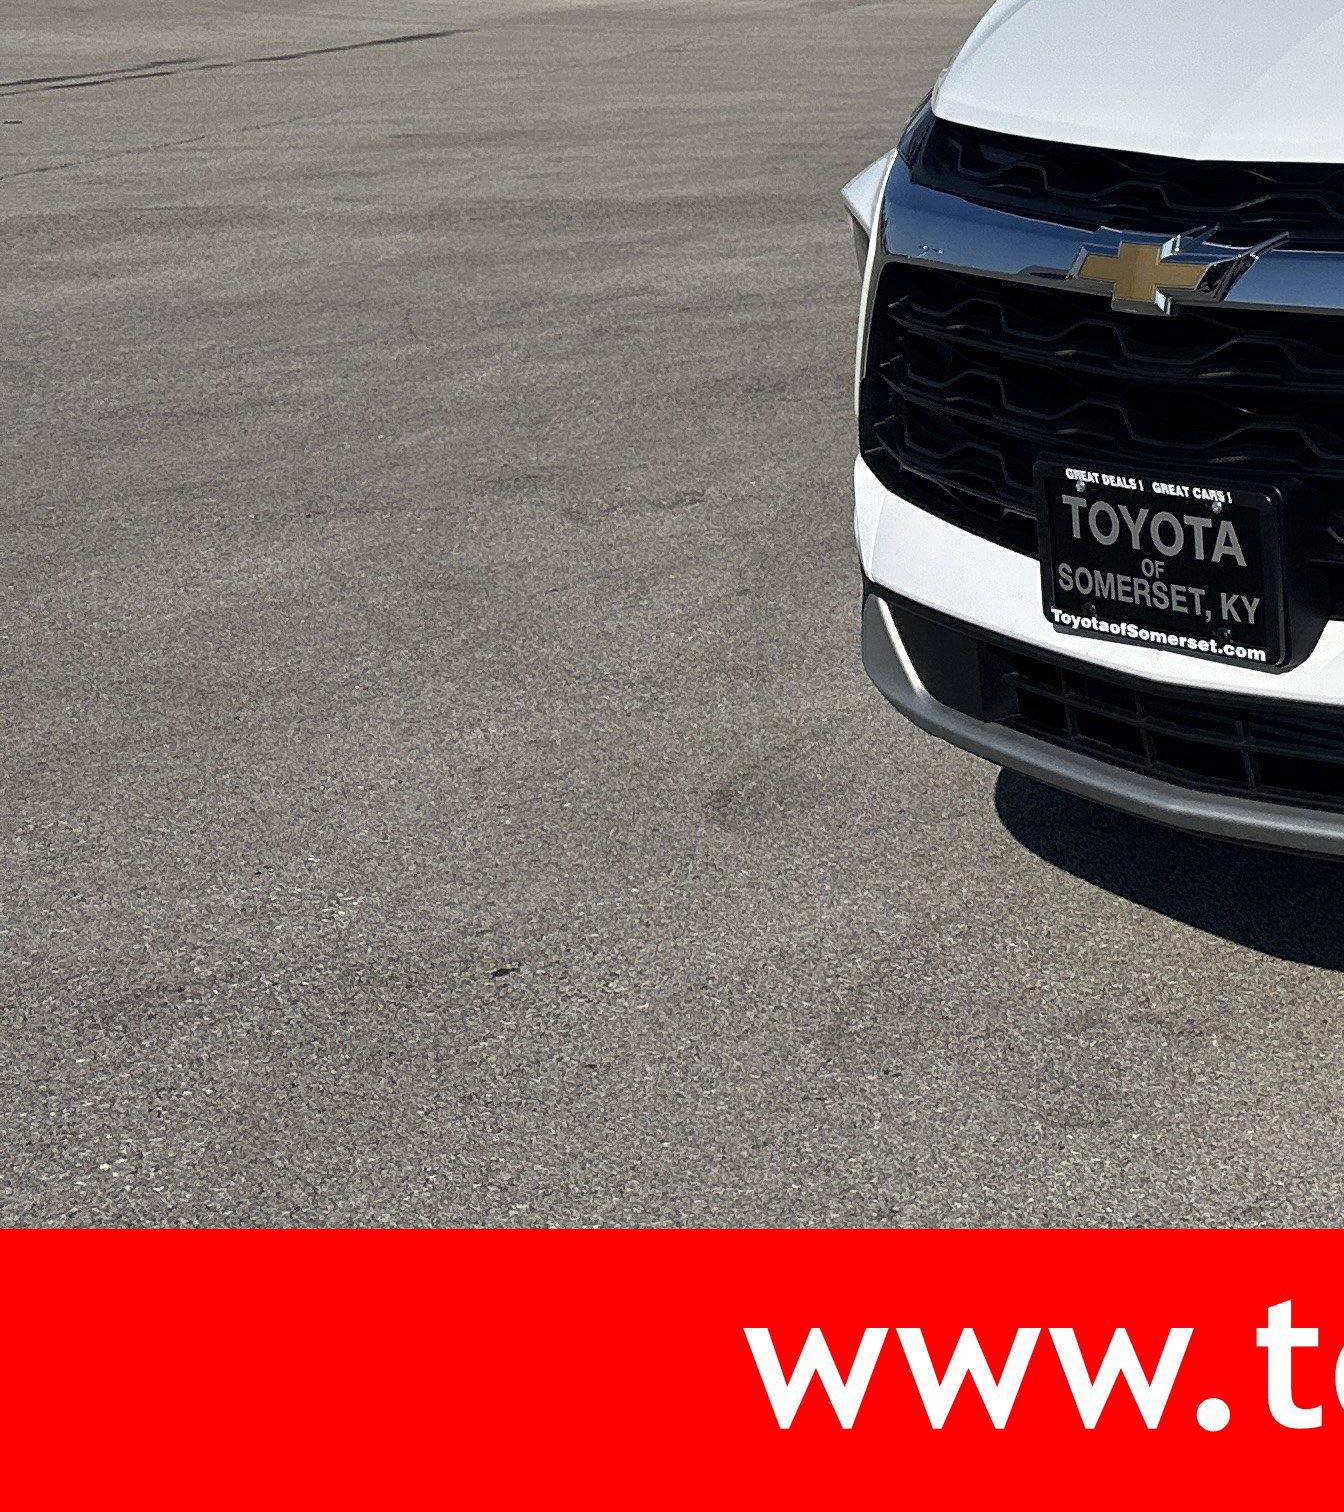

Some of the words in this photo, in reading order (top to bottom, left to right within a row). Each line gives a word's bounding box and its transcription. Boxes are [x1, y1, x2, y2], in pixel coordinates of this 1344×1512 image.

[1065, 468, 1099, 484] GREAT
[1152, 481, 1190, 498] GREAT
[1061, 494, 1247, 567] TOYOTA
[1057, 563, 1213, 623] SOMERSET,
[1220, 592, 1261, 625] KY
[1141, 558, 1165, 579] OF
[1050, 608, 1267, 661] ToyotaofSomerset.com
